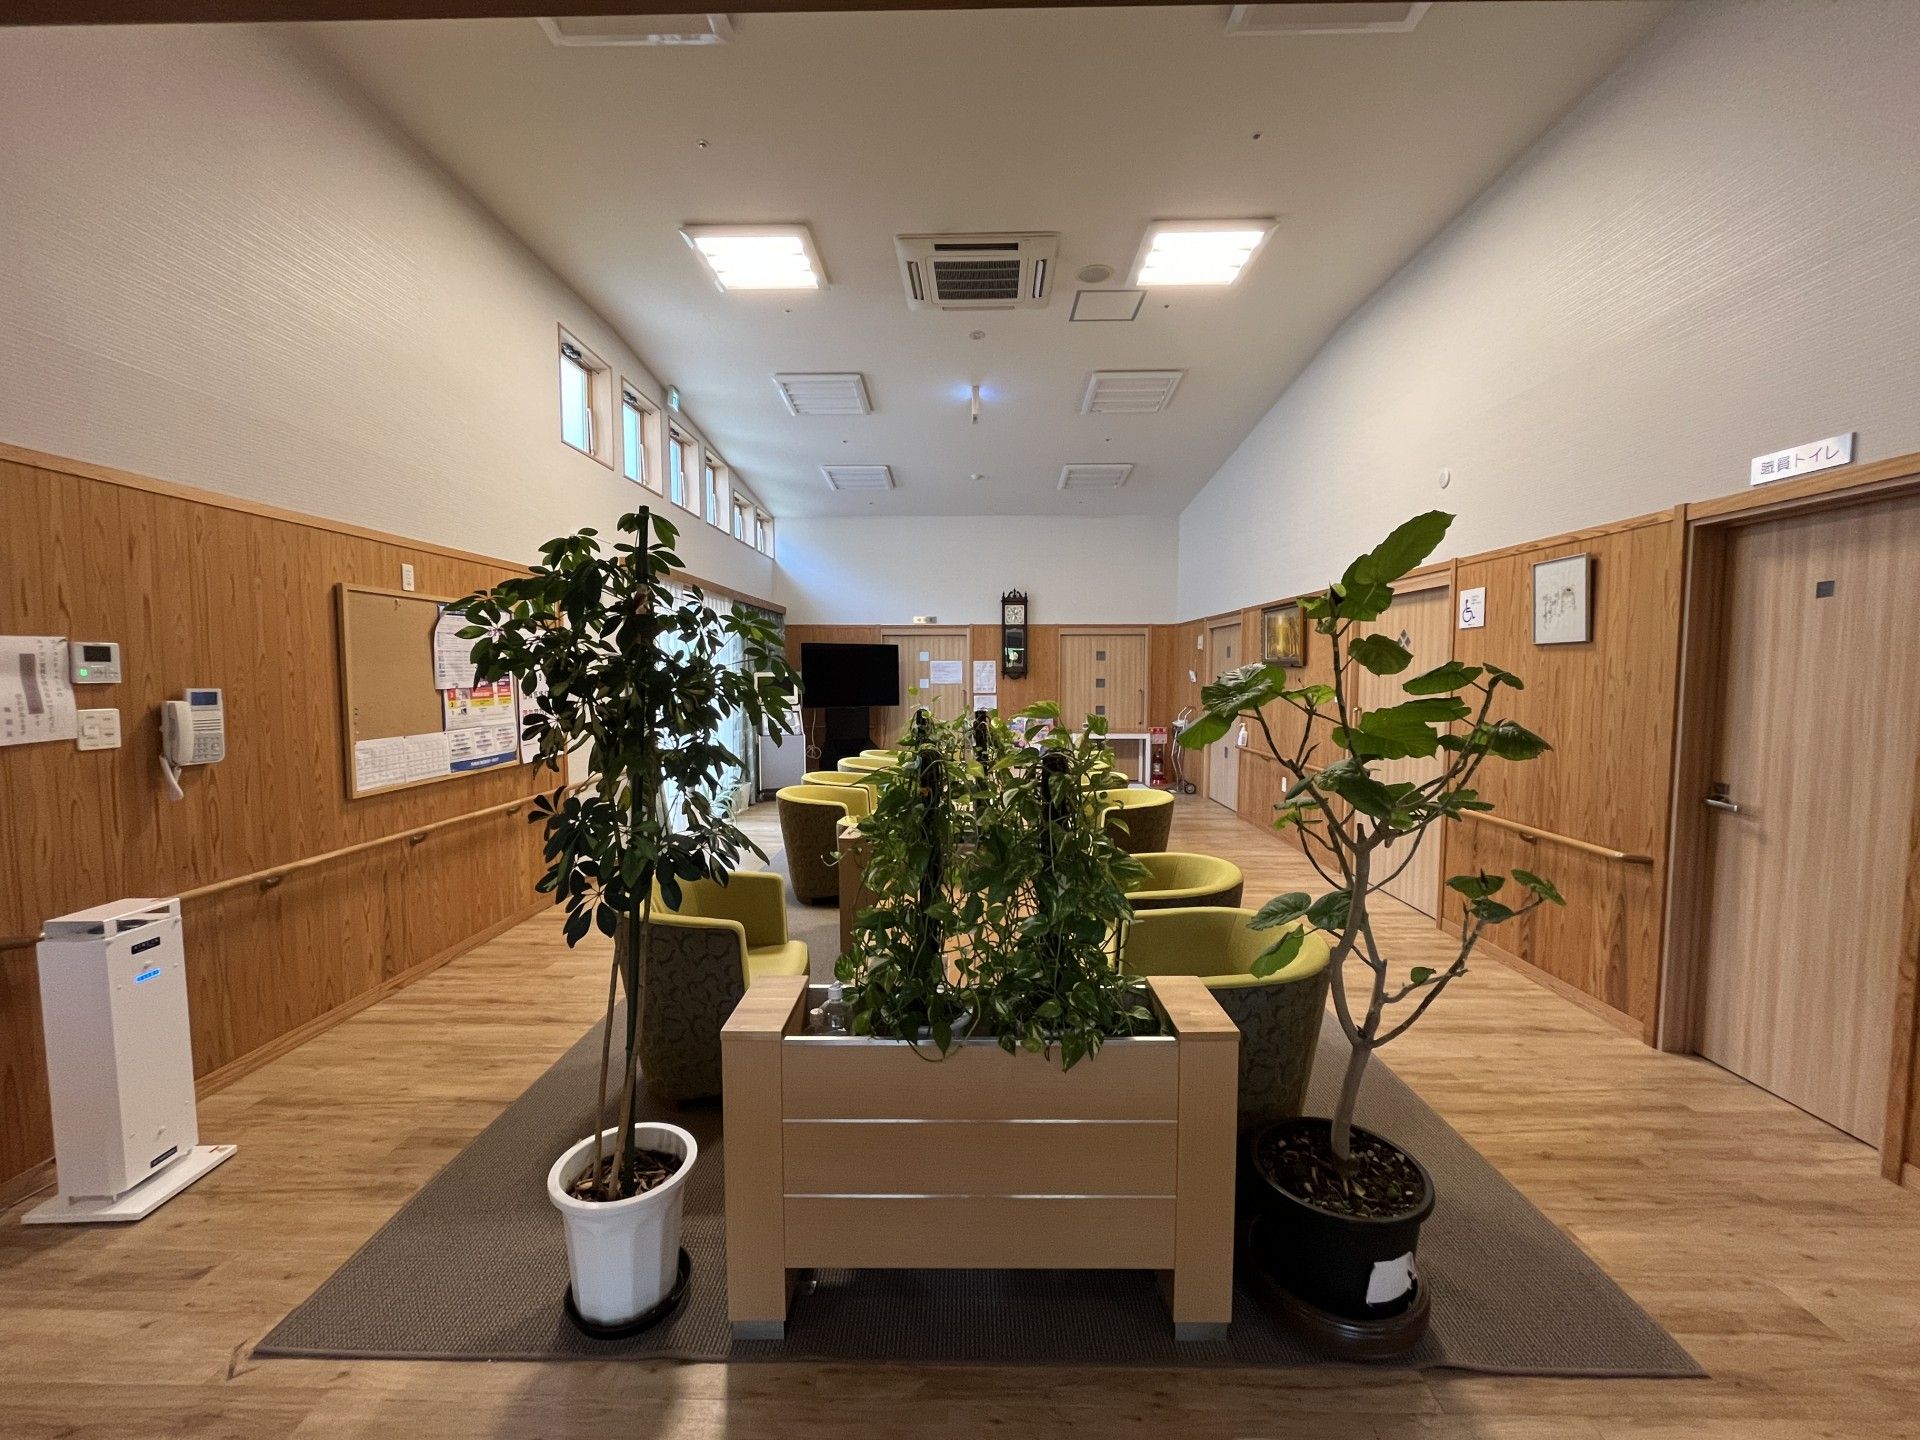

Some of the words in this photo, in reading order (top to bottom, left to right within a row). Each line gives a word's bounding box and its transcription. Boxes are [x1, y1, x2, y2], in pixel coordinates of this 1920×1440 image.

[1760, 445, 1840, 474] 職員トイレ
